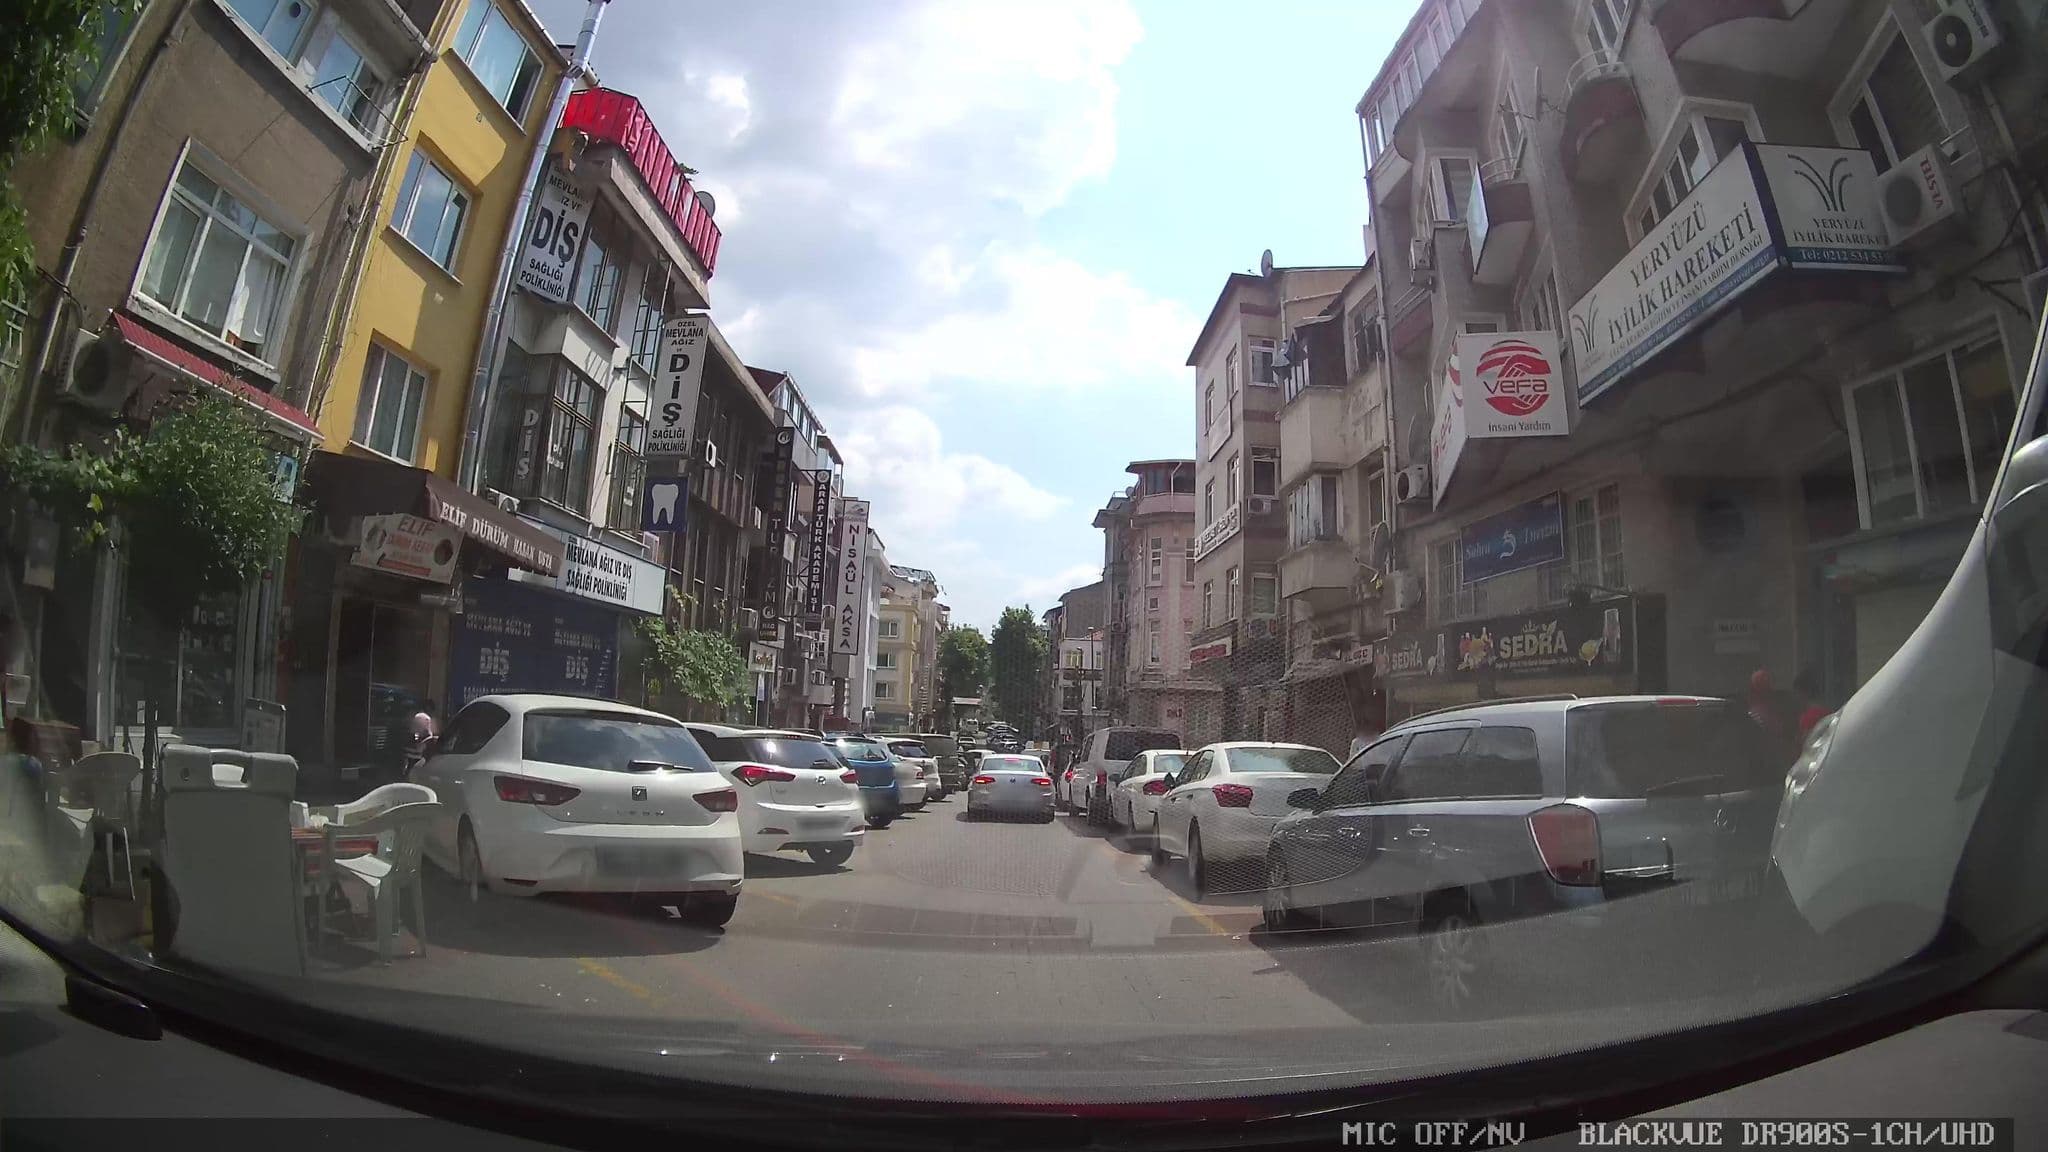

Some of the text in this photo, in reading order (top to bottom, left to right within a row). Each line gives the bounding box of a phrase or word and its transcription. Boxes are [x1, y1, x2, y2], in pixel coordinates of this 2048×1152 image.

[531, 206, 579, 269] DİŞ
[1630, 200, 1706, 289] YERYÜZÜ
[1823, 250, 1848, 260] 0212
[528, 257, 564, 283] SAĞLIĞI
[1608, 293, 1659, 345] İYİLİK
[1660, 202, 1757, 304] HAREKETİ
[665, 328, 704, 338] MEVLANA
[670, 338, 695, 346] AĞIZ
[662, 353, 690, 428] DİŞ
[647, 441, 688, 452] POLİKLİNİĞİ
[652, 427, 685, 440] SAĞLIĞI
[816, 483, 827, 512] ARAP
[440, 501, 468, 529] ELİF
[471, 518, 509, 550] DÜRÜM
[566, 543, 632, 584] MEVLANA AĞIZ VE DİŞ
[566, 567, 628, 601] SAĞLIĞI POLİKLİNİĞİ
[839, 603, 853, 650] AKSA
[1499, 630, 1568, 659] SEDRA
[1392, 648, 1423, 671] SEDRA
